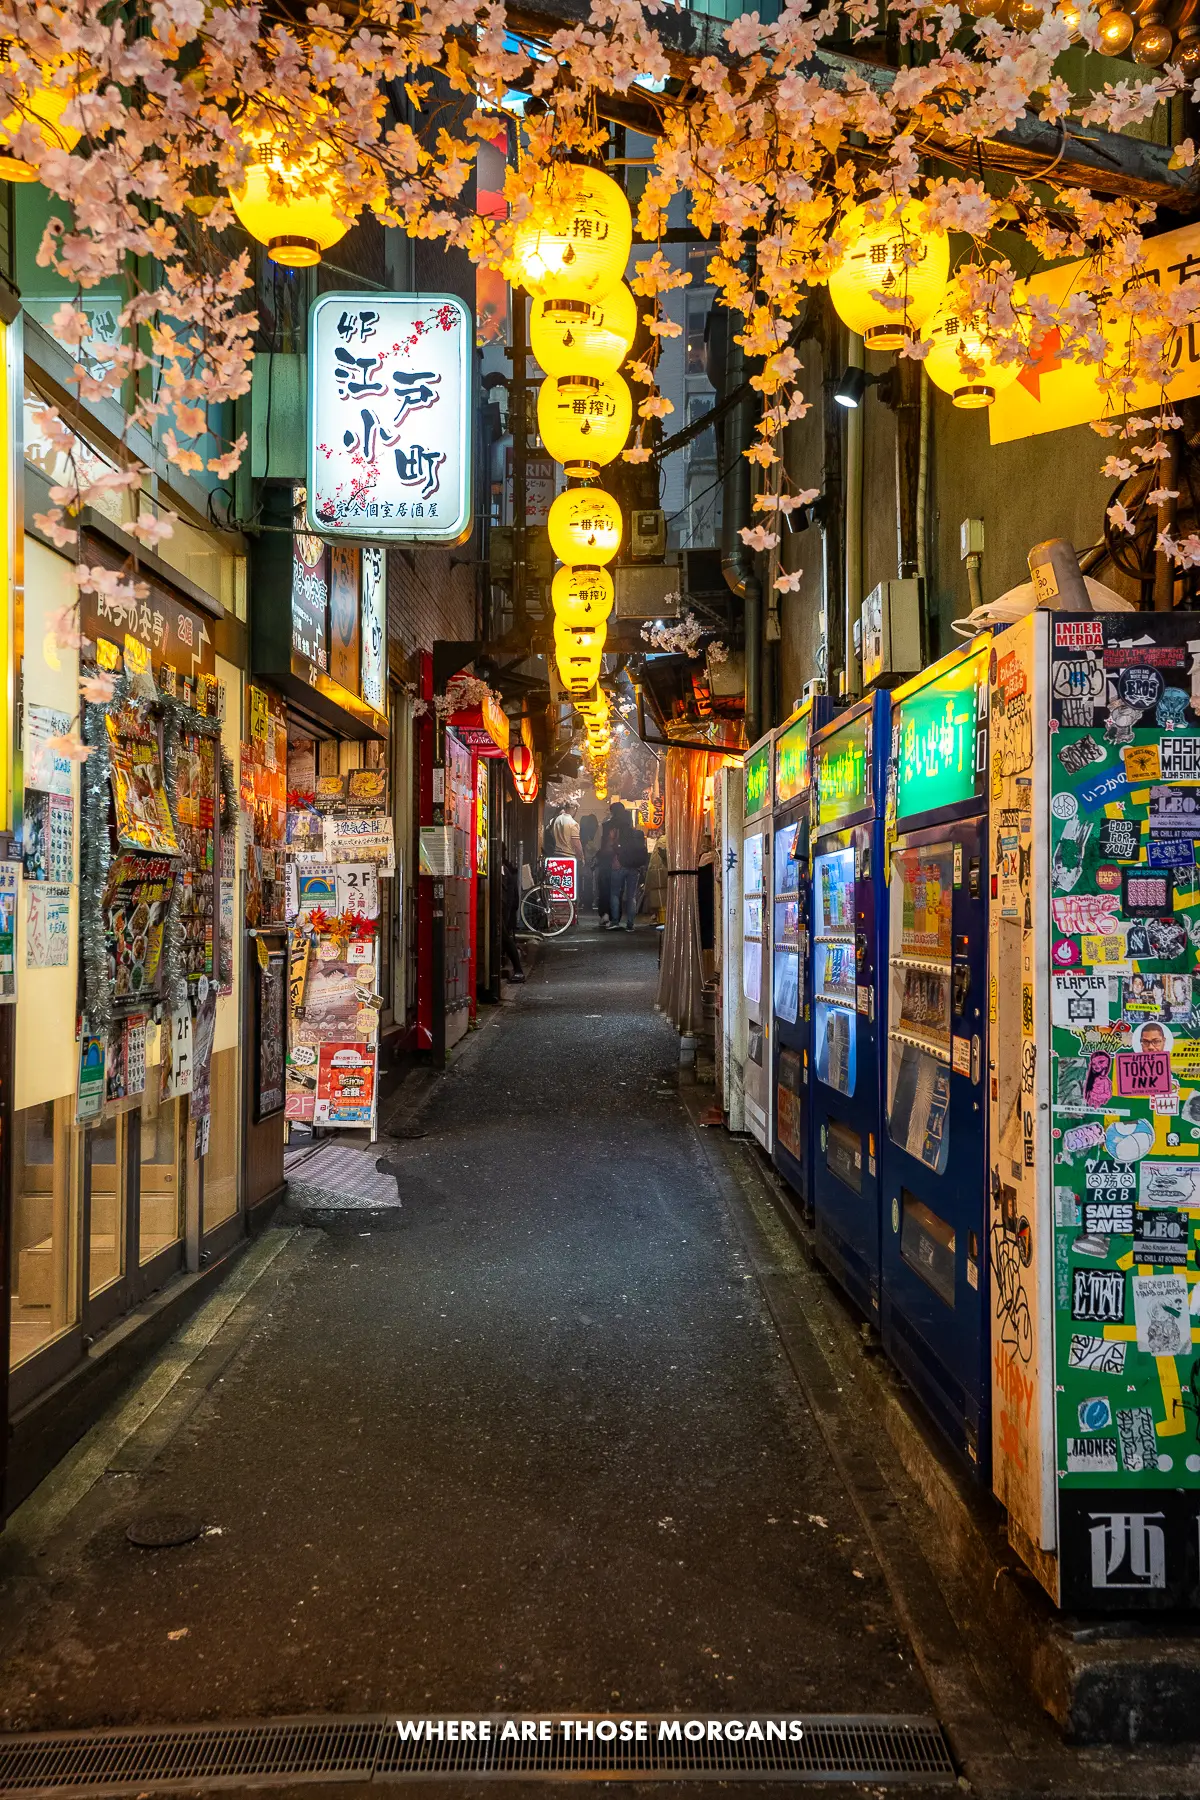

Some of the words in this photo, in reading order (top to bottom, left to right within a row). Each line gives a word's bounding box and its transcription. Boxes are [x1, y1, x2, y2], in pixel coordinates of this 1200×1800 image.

[555, 217, 609, 241] 搾り
[558, 399, 616, 417] 一番搾り
[508, 463, 551, 477] RIN
[335, 501, 440, 519] 完全個室居酒屋
[569, 519, 614, 532] 一番搾り
[568, 590, 607, 601] 一番搾り
[1056, 622, 1102, 634] INTER
[1056, 634, 1103, 646] MERDA
[1104, 649, 1130, 657] ENJOY
[904, 699, 970, 785] 思い出横丁
[821, 739, 863, 802] 思い出横丁
[1159, 797, 1196, 813] LEO
[1108, 820, 1133, 833] GOOD
[1110, 832, 1131, 844] FOR
[347, 872, 370, 887] 2F
[1056, 976, 1106, 989] FLAMER
[177, 1016, 189, 1040] 2F
[1132, 1054, 1156, 1062] LITTLE
[1123, 1060, 1165, 1077] TOKYO
[1132, 1076, 1158, 1088] INK
[286, 1096, 315, 1115] 2F
[1093, 1188, 1130, 1201] RGB
[1086, 1204, 1133, 1219] SAVES
[1086, 1219, 1133, 1233] SAVES
[1143, 1221, 1181, 1238] LEO
